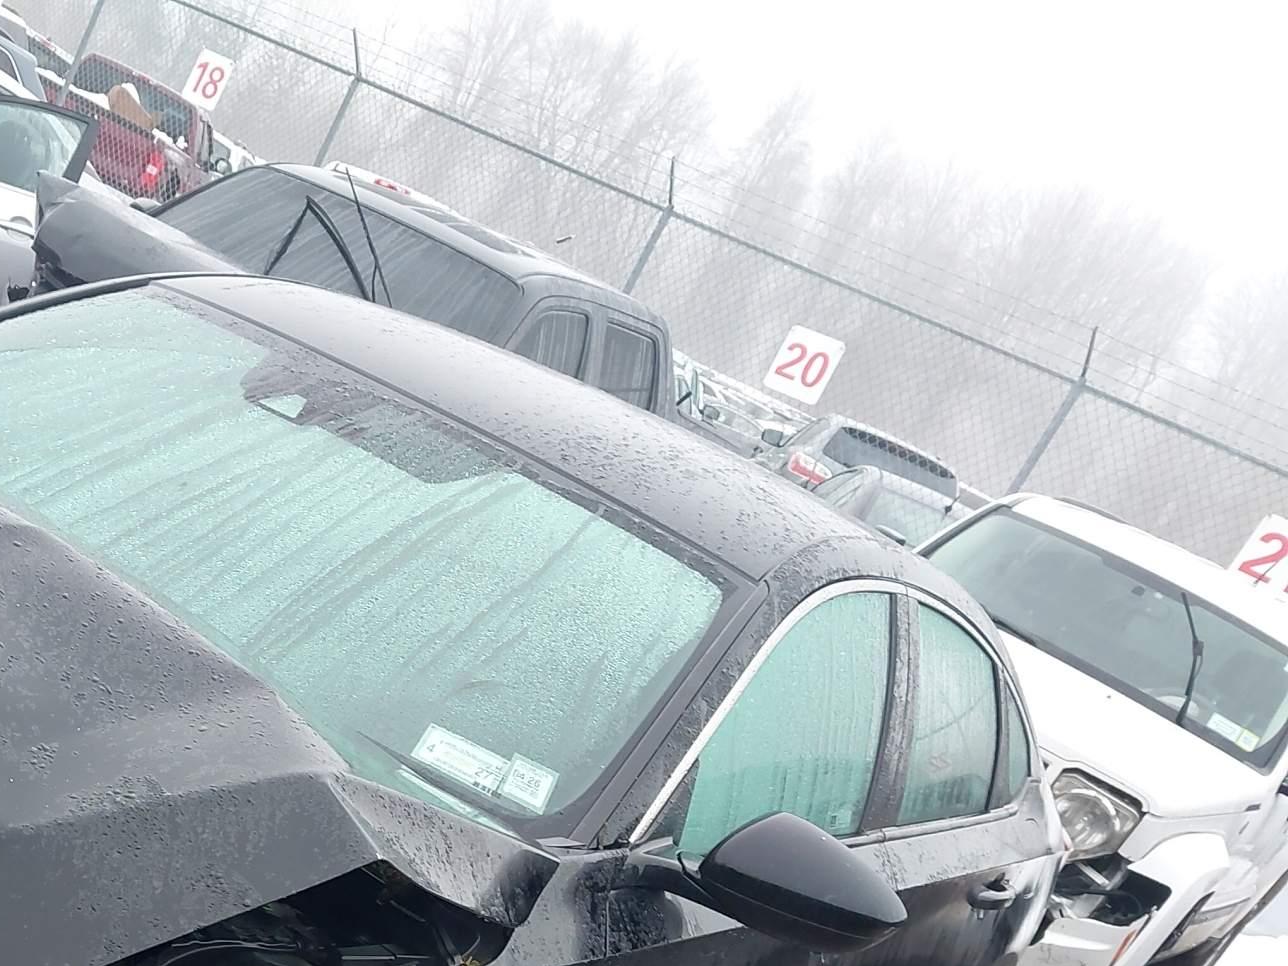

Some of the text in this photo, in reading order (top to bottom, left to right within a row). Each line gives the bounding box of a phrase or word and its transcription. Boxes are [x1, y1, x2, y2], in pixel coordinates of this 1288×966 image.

[193, 62, 224, 99] 18
[775, 343, 829, 387] 20
[1238, 532, 1288, 592] 2
